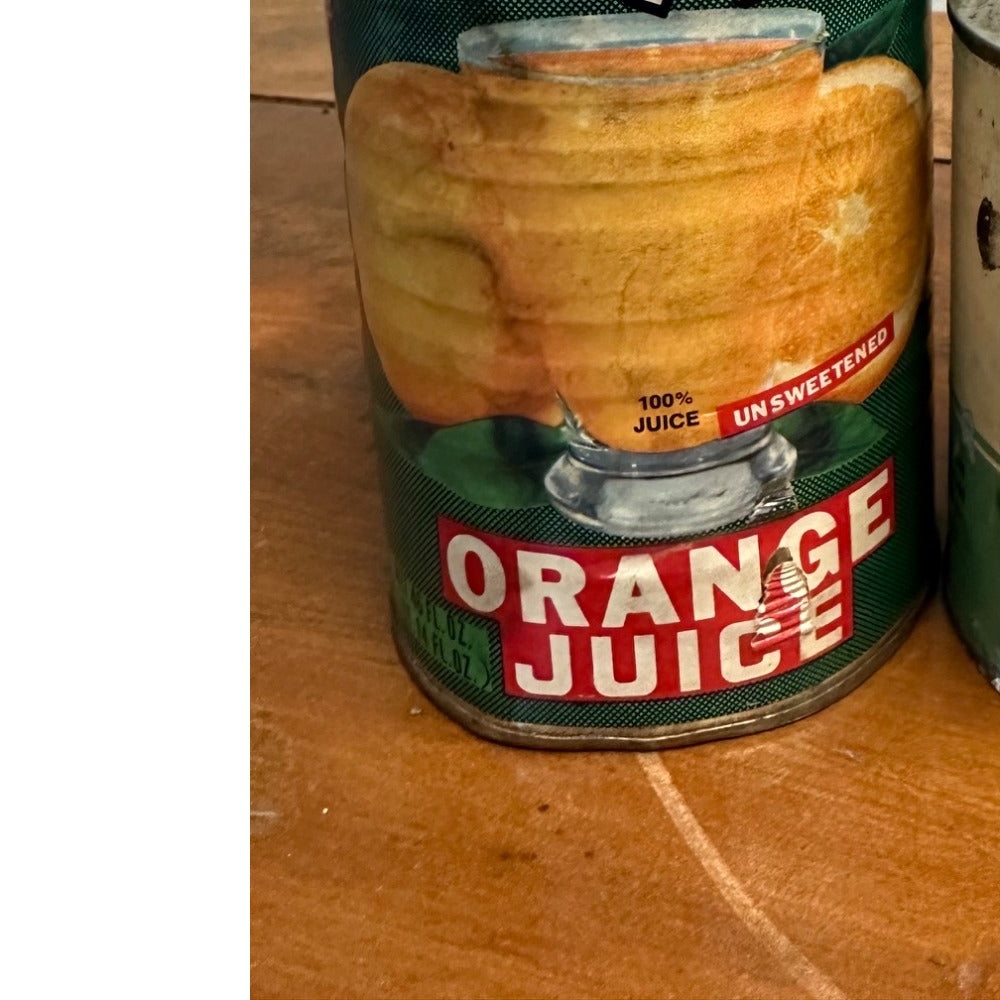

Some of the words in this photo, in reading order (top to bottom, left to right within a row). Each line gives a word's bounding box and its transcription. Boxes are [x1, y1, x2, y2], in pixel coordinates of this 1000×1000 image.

[633, 411, 700, 434] JUICE
[637, 391, 694, 412] 100%
[733, 327, 888, 428] UNSWEETENED
[446, 467, 891, 627] ORANGE
[514, 578, 843, 698] JUICE
